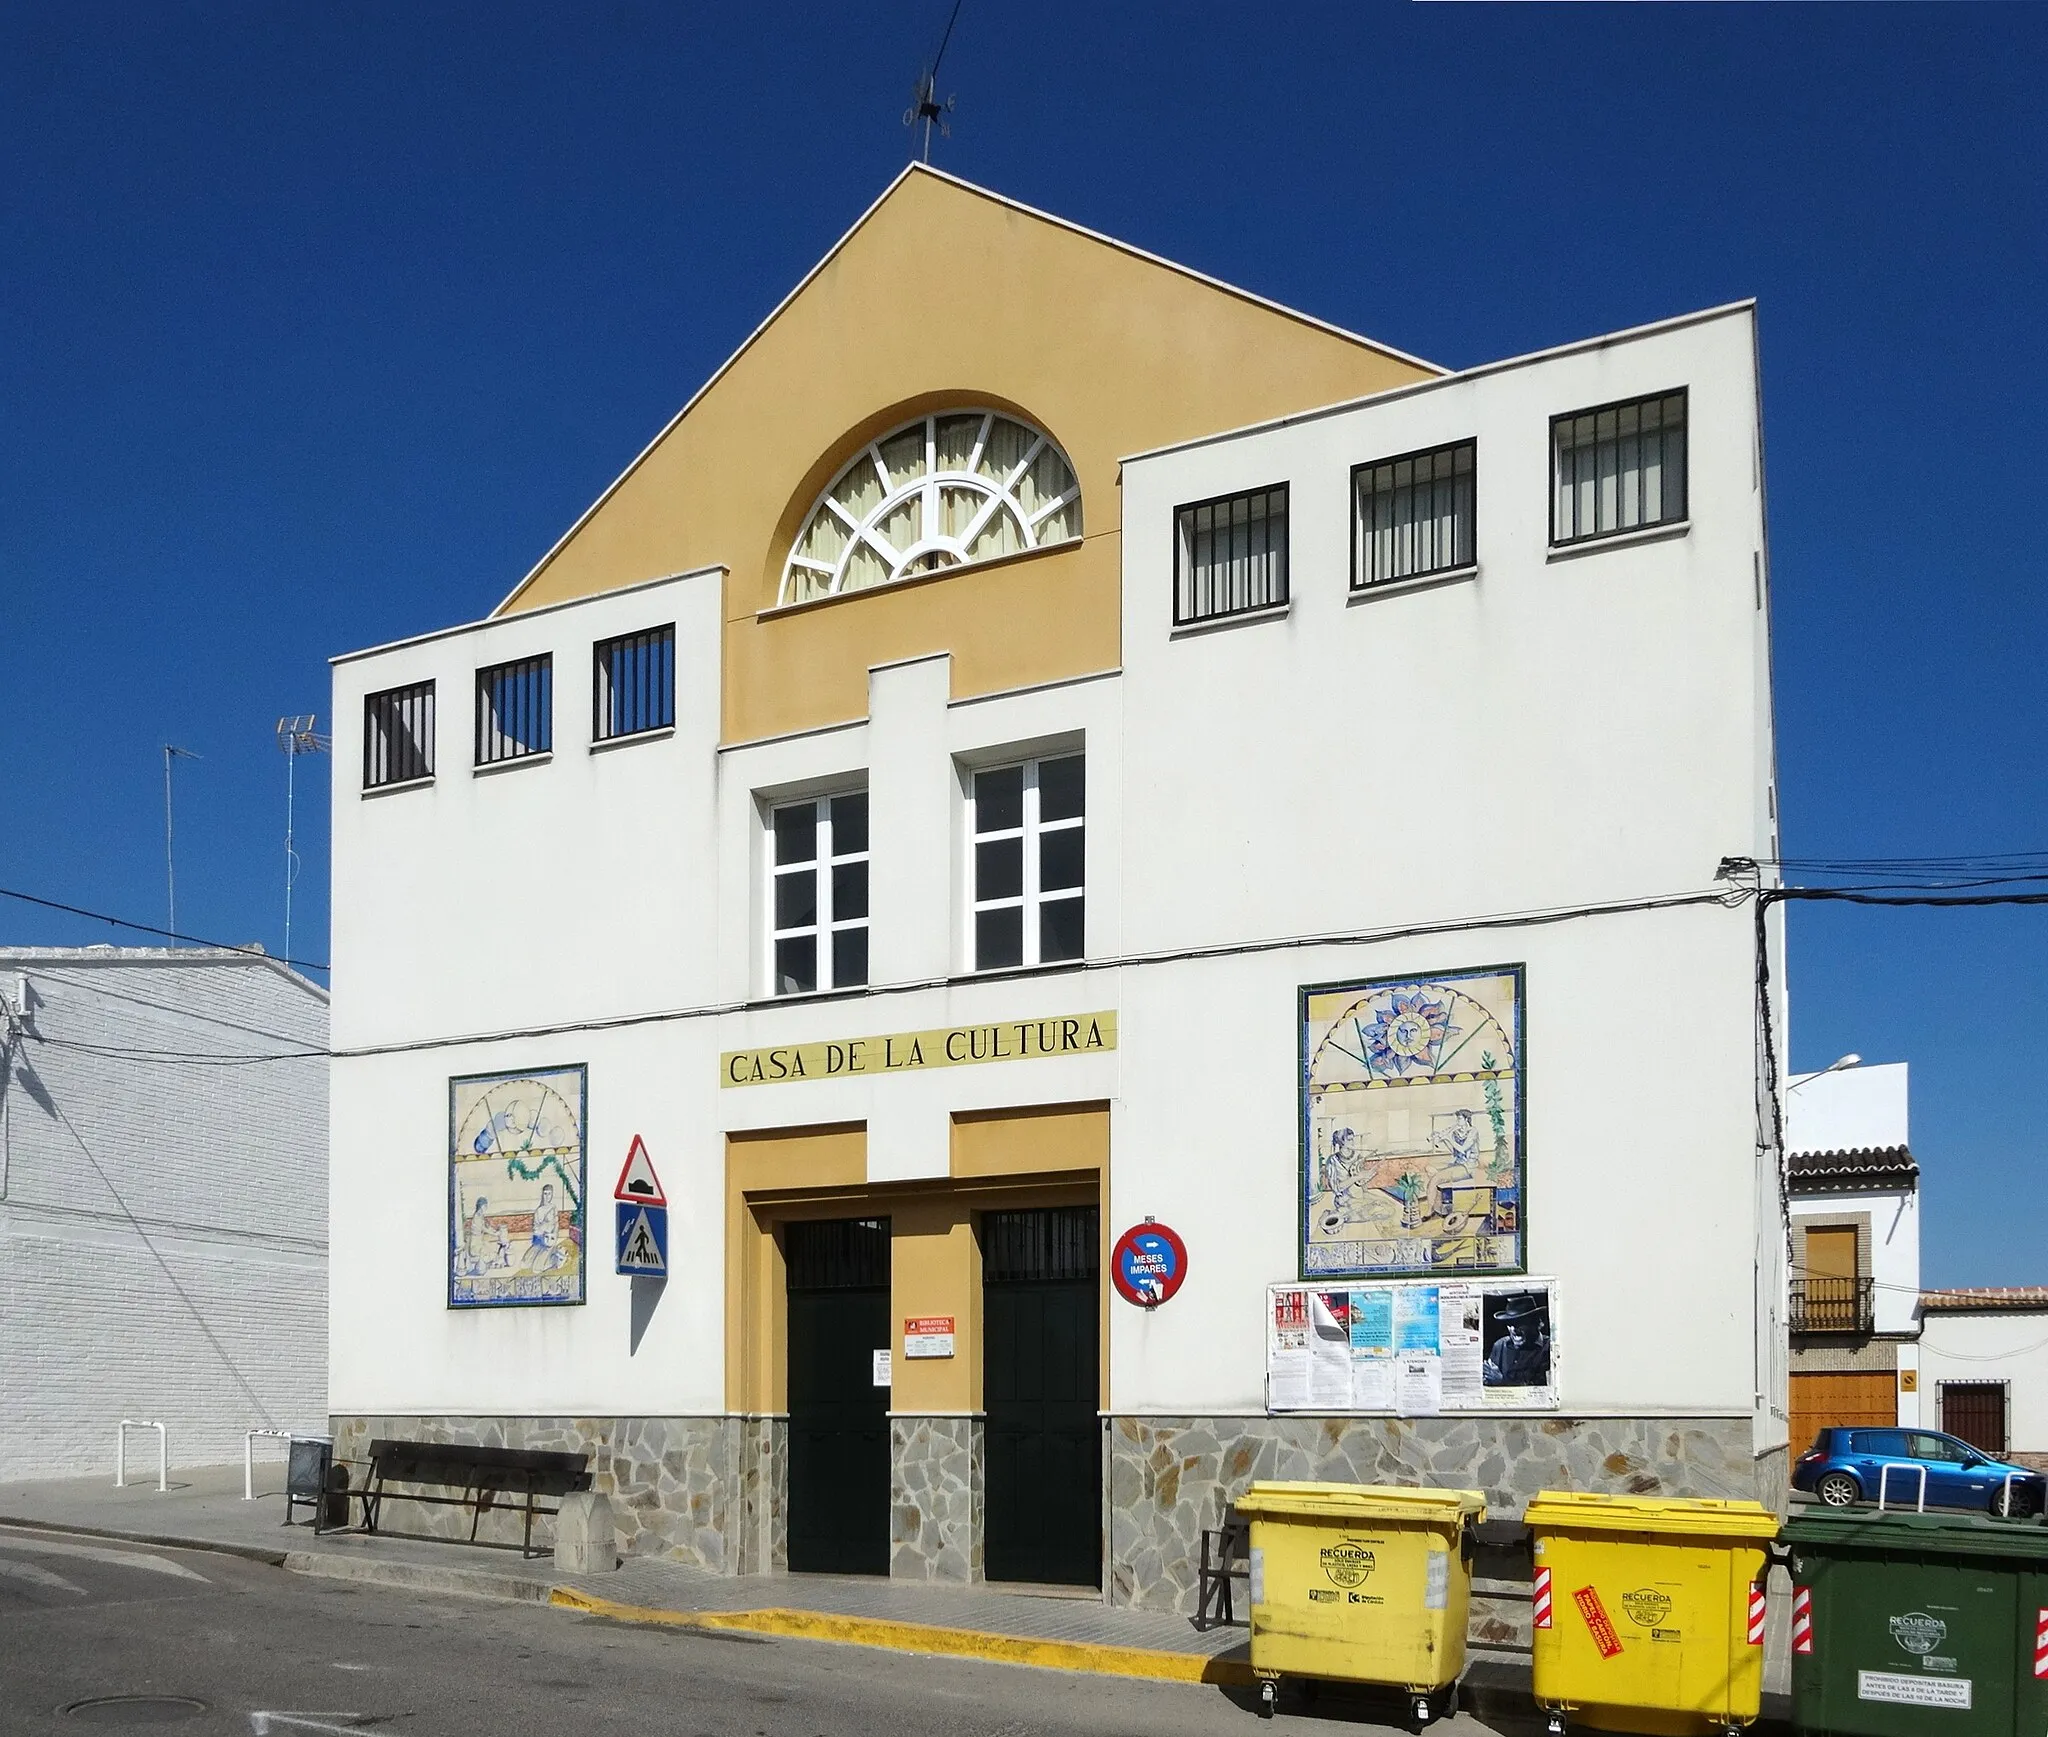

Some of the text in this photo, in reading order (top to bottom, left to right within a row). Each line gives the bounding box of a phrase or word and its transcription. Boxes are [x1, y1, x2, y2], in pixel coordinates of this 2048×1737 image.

[729, 1018, 1105, 1083] CASA DE LA CULTURA
[1133, 1254, 1163, 1263] MESES
[1130, 1264, 1168, 1275] IMPARES
[1320, 1548, 1375, 1559] RECUERDA
[1622, 1593, 1671, 1602] RECUERDA
[1575, 1594, 1591, 1619] VIDRIO
[1590, 1625, 1608, 1654] BASURA
[1587, 1588, 1620, 1651] PROHIBIDO DEPOSITAR
[1889, 1616, 1947, 1628] RECUERDA
[1865, 1675, 1899, 1684] PROHIBIDO
[1900, 1679, 1936, 1687] DEPOSITAR
[1943, 1697, 1967, 1705] NOCHE
